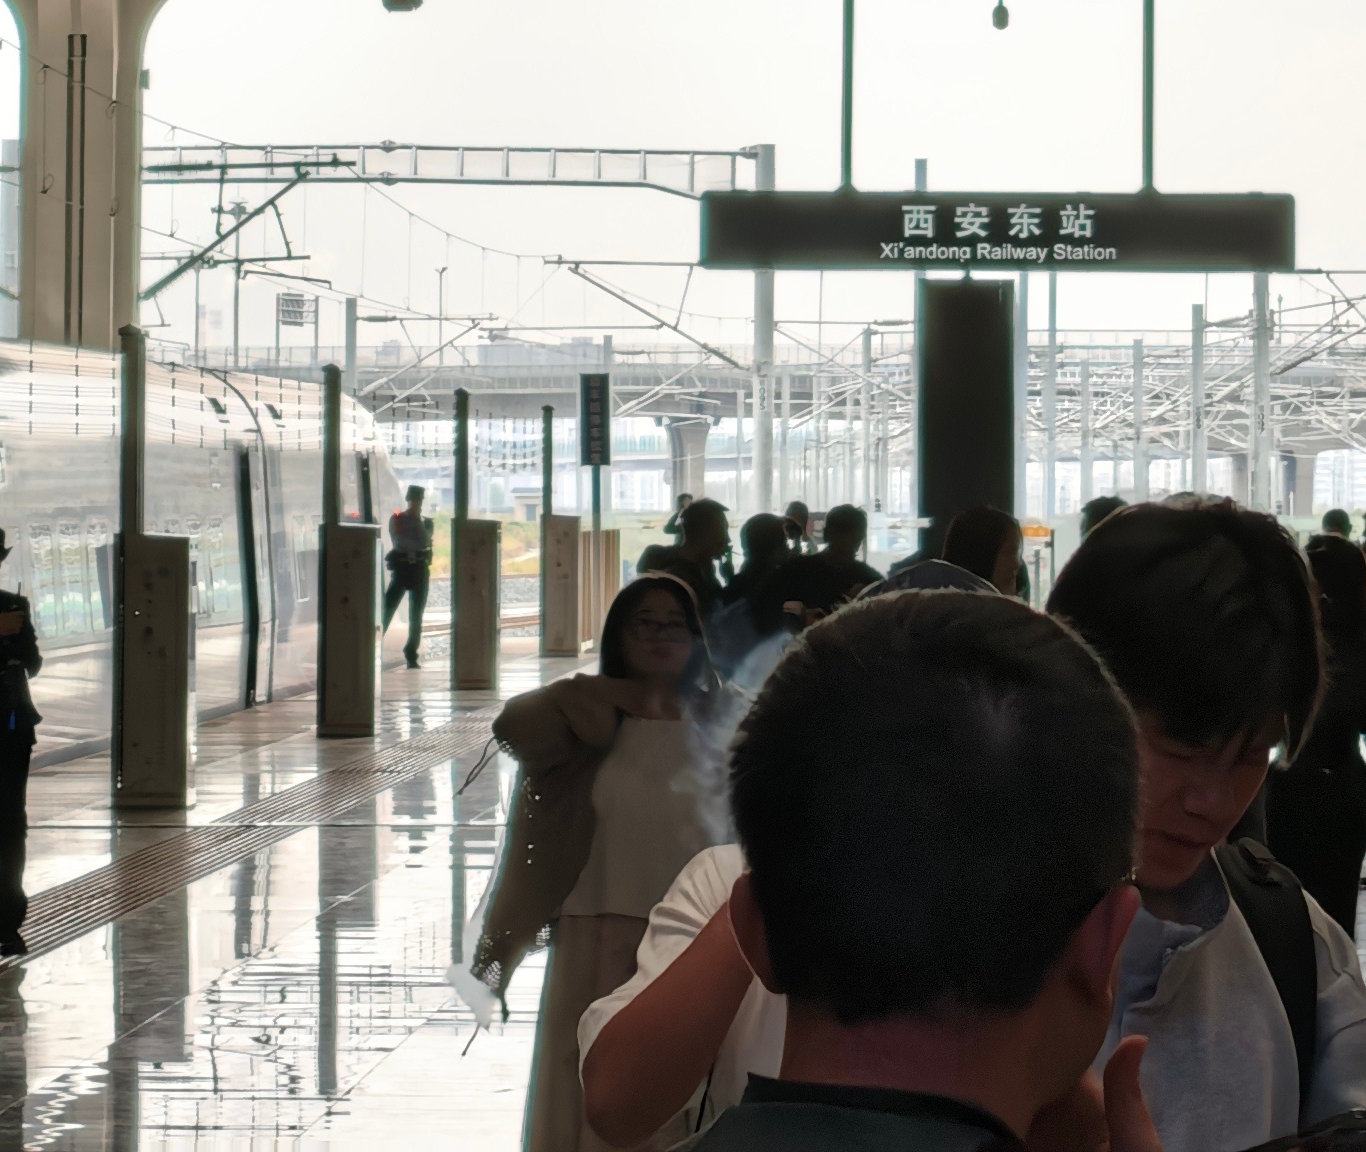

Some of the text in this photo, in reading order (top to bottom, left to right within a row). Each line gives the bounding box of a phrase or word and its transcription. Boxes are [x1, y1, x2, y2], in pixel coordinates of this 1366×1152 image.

[901, 202, 1096, 238] 西安东站
[879, 242, 1117, 263] Xi'andong Railway Station
